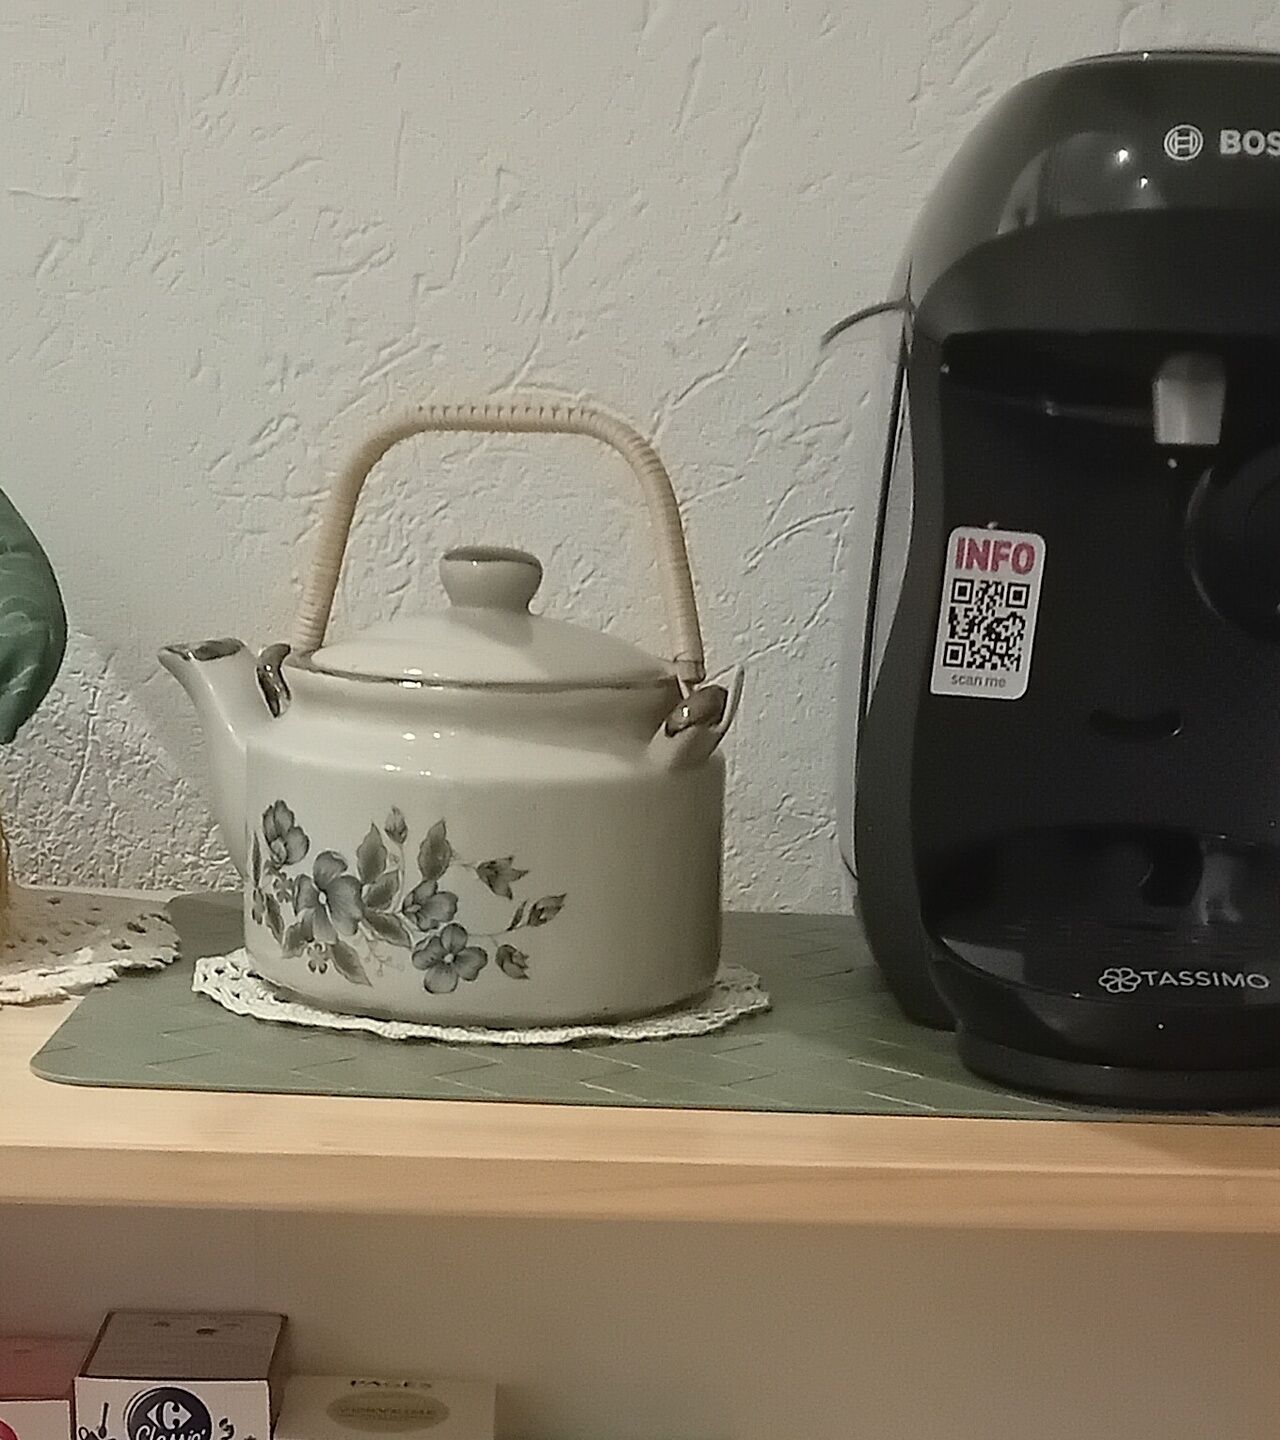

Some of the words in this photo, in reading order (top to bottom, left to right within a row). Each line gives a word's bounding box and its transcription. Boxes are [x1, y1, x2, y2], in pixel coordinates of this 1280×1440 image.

[955, 537, 1036, 575] INFO
[951, 674, 982, 686] scan
[986, 677, 1007, 688] me
[1141, 969, 1271, 989] TASSIMO
